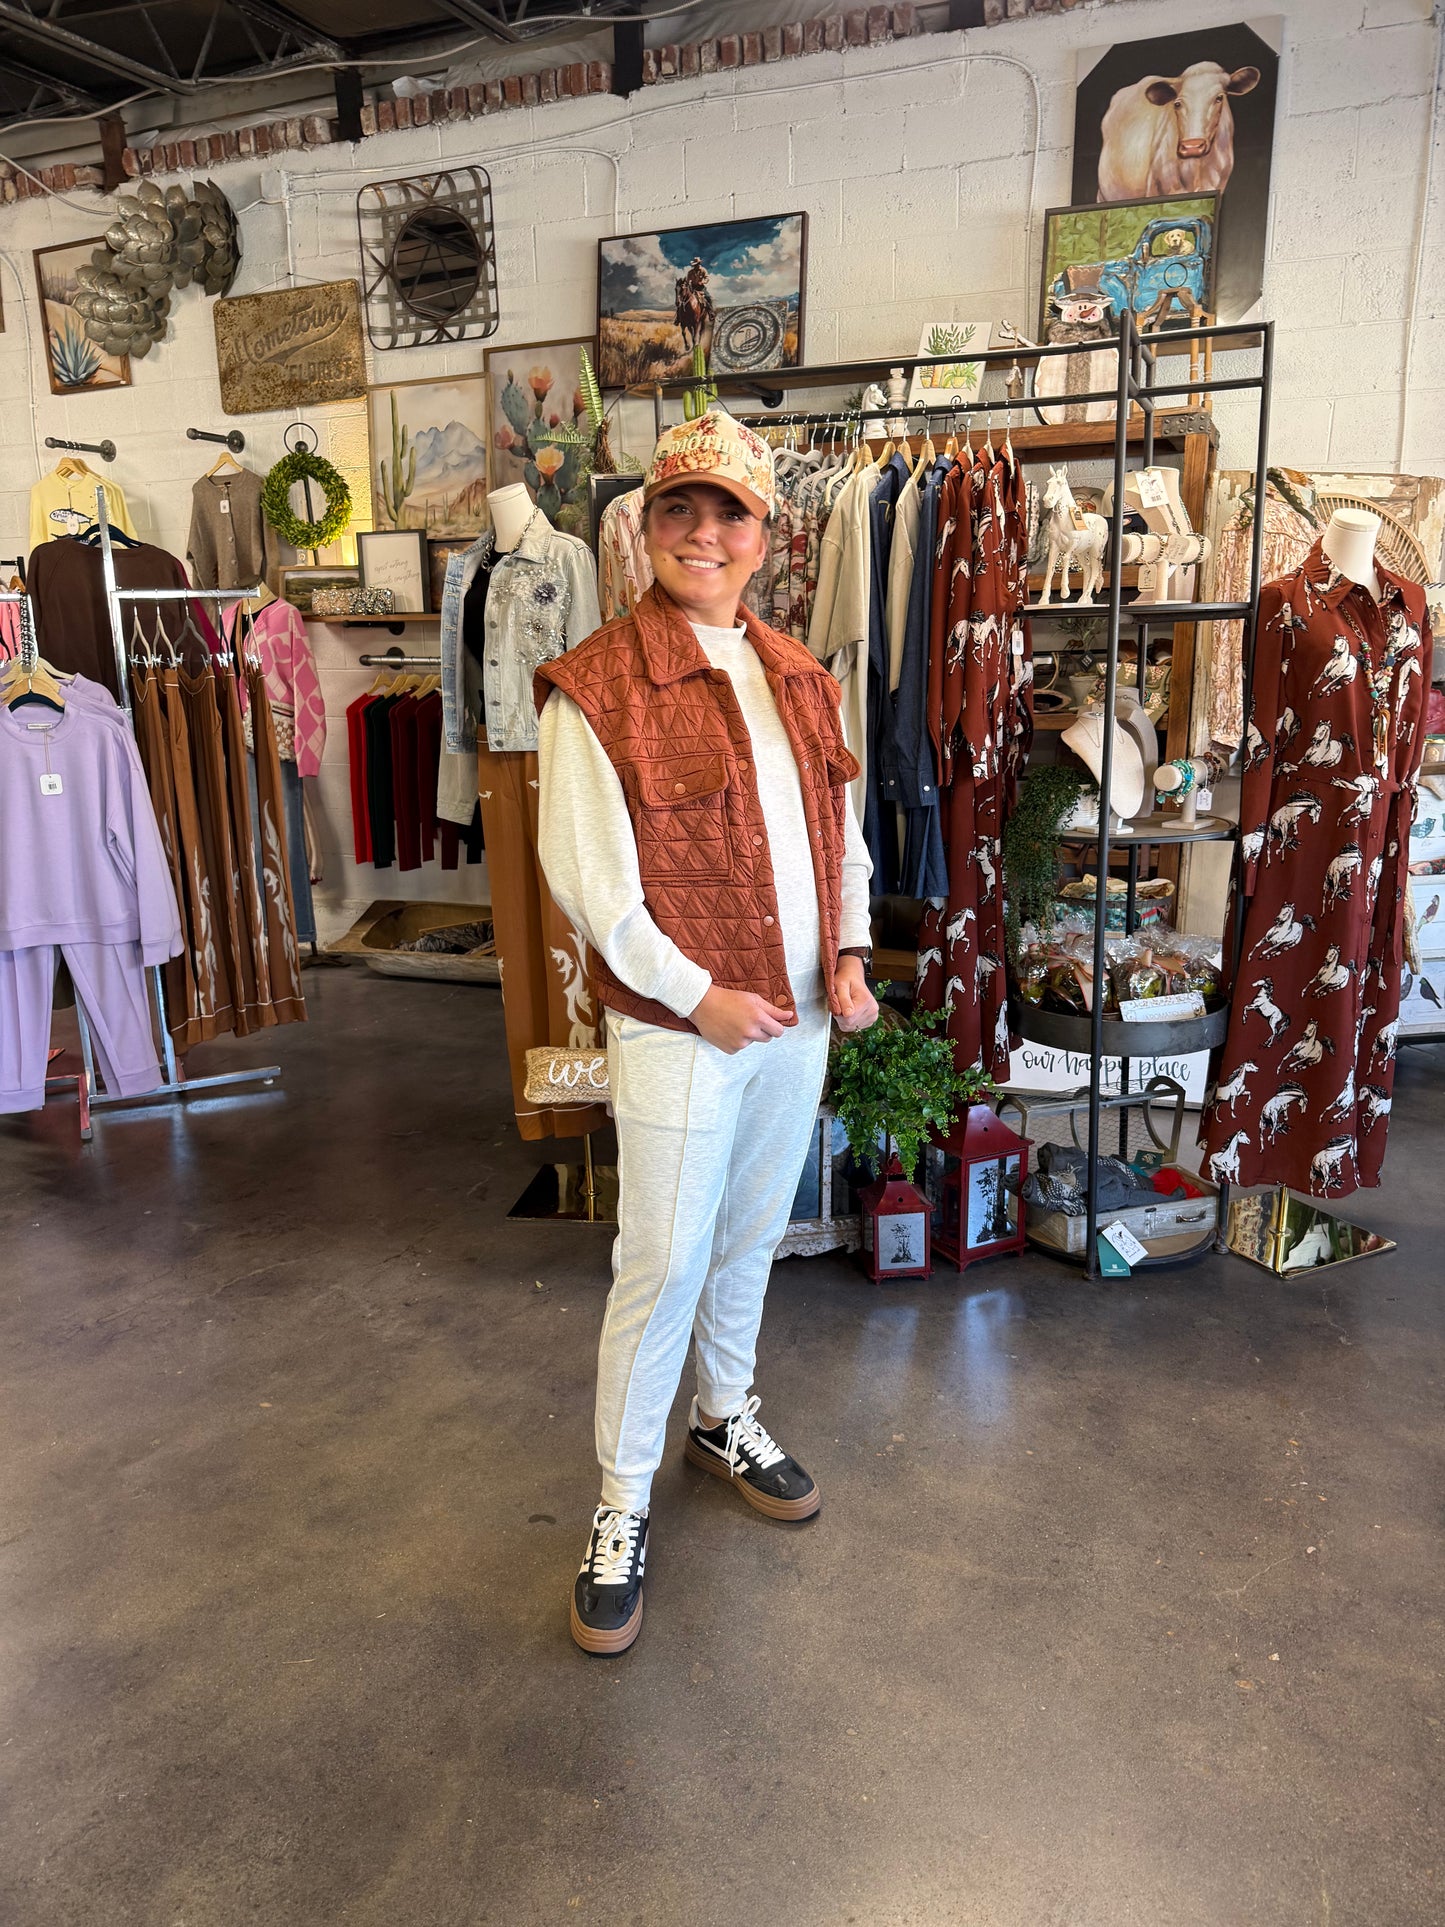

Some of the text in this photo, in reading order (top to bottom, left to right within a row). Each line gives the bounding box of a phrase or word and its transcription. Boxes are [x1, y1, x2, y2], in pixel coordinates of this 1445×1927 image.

[1022, 1050, 1191, 1090] our hapy place
